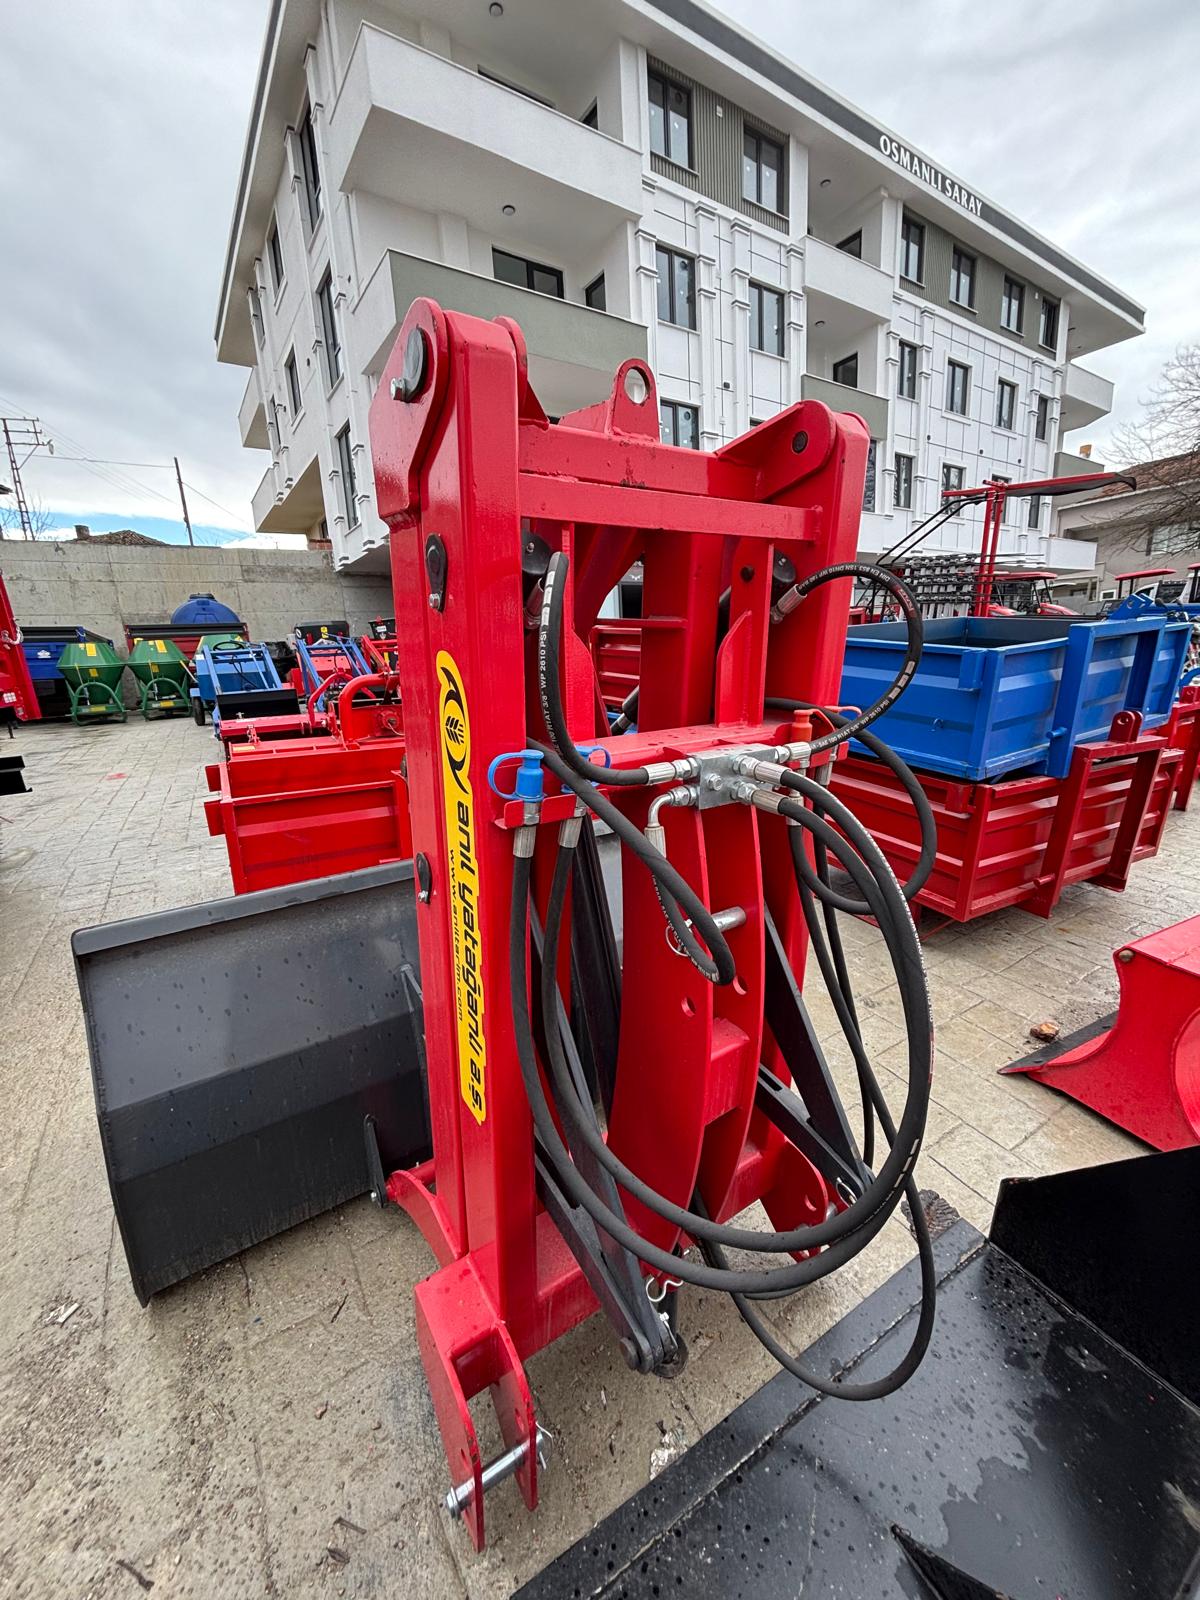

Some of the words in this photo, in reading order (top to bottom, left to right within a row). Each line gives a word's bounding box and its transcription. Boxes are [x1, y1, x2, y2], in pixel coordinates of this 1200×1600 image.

[880, 134, 942, 192] OSMANLI
[944, 179, 983, 217] SARAY
[540, 631, 548, 648] PSI
[540, 673, 547, 689] WP
